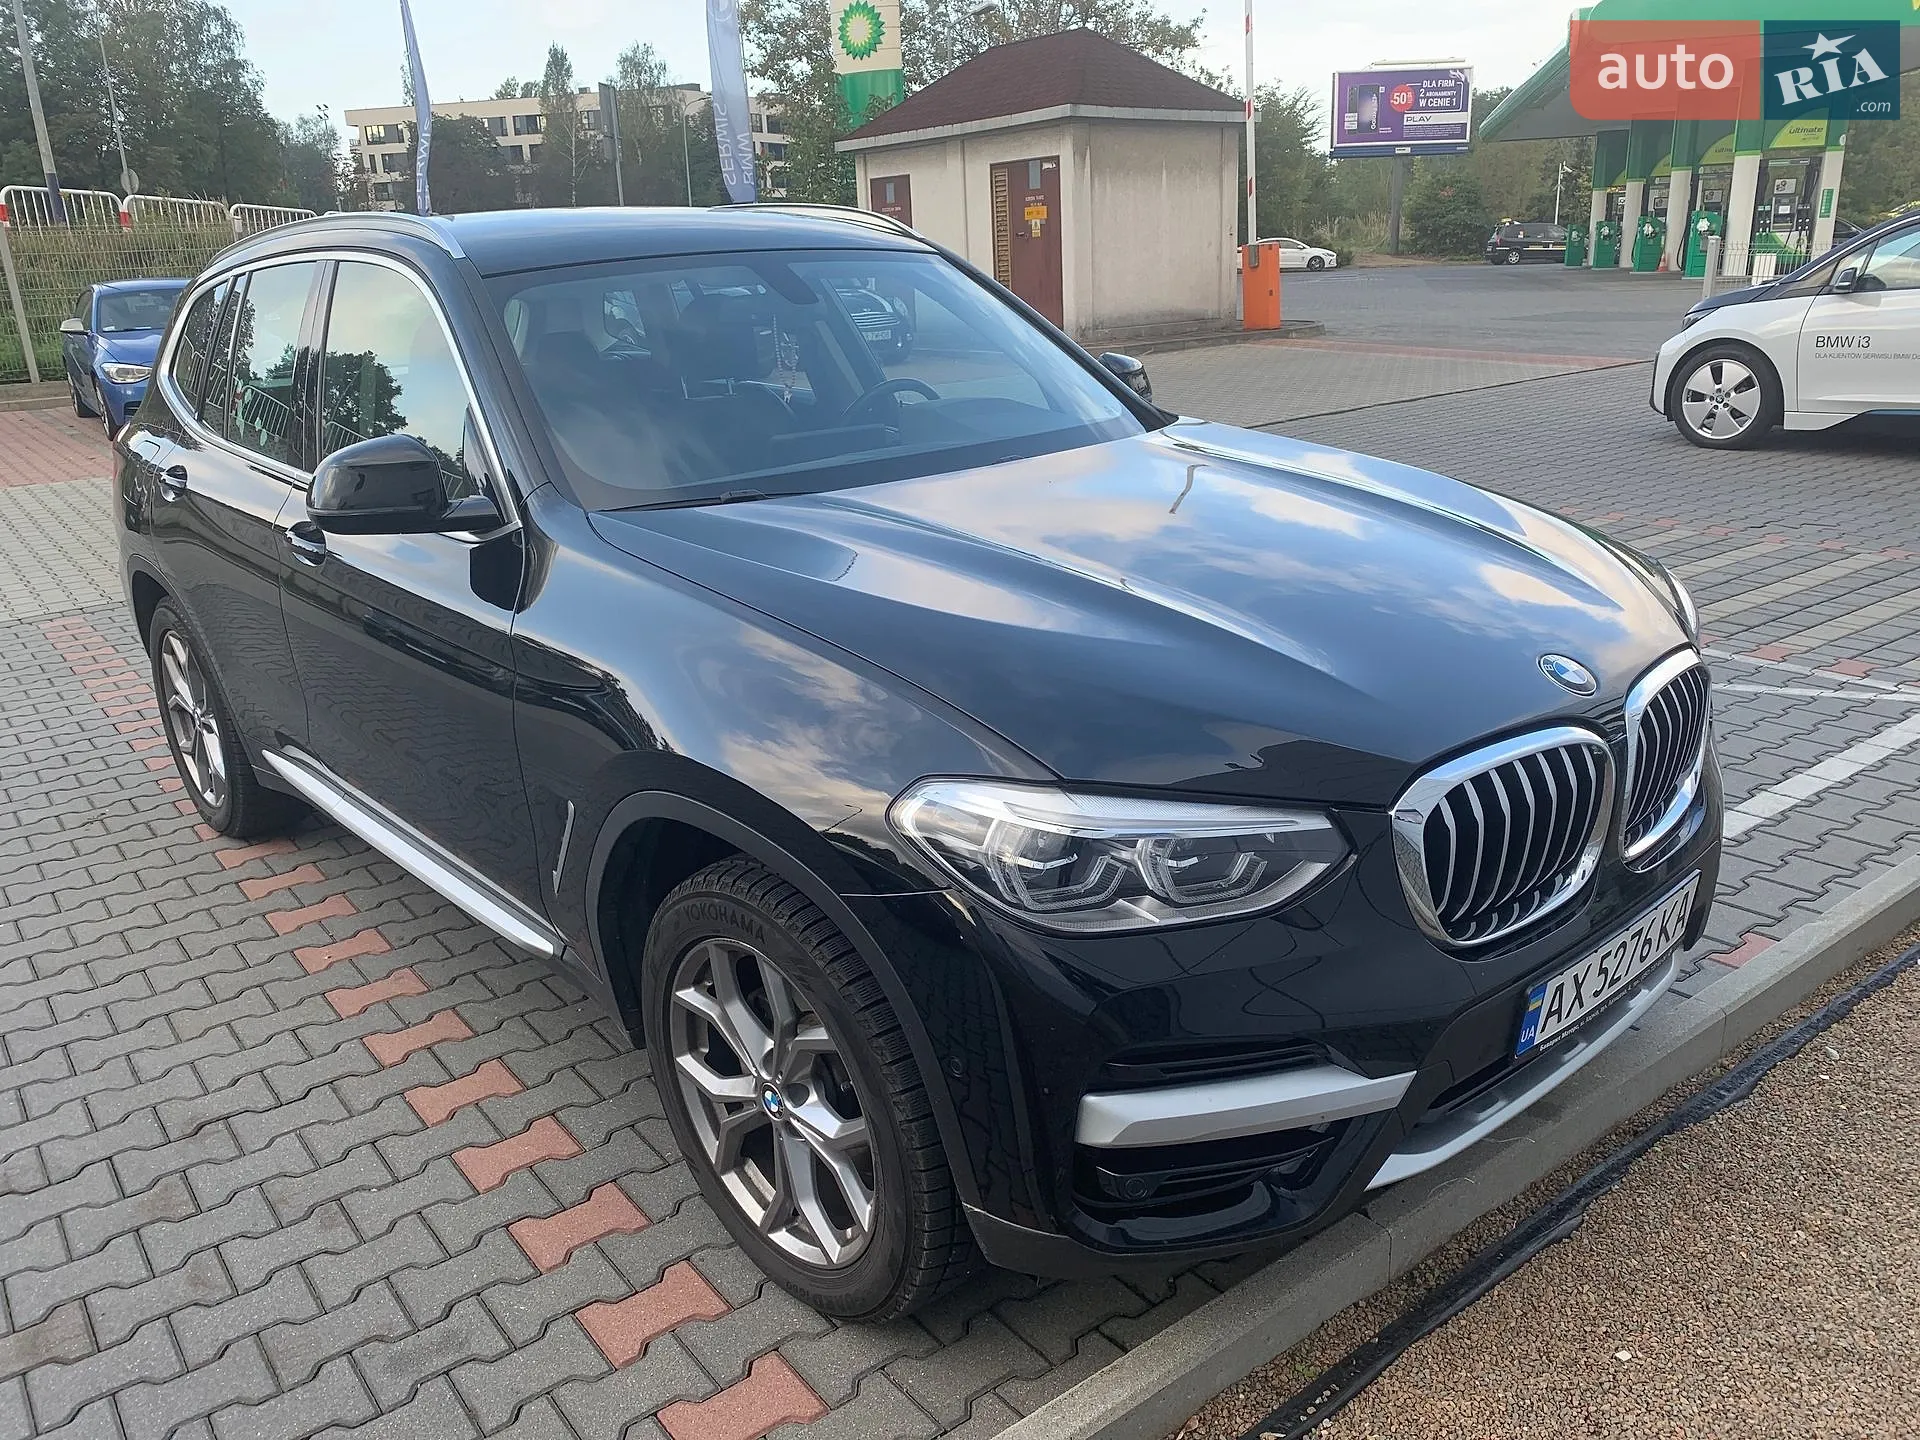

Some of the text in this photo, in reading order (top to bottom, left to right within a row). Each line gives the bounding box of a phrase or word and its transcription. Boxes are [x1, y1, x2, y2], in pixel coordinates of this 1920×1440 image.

[1422, 79, 1455, 88] DLA FIRM
[1419, 88, 1425, 97] 2
[1419, 98, 1427, 107] W
[1428, 97, 1451, 107] CENIE
[1815, 335, 1871, 348] BMW i3
[682, 902, 766, 946] YOKOHAMA
[1521, 1024, 1535, 1043] UA
